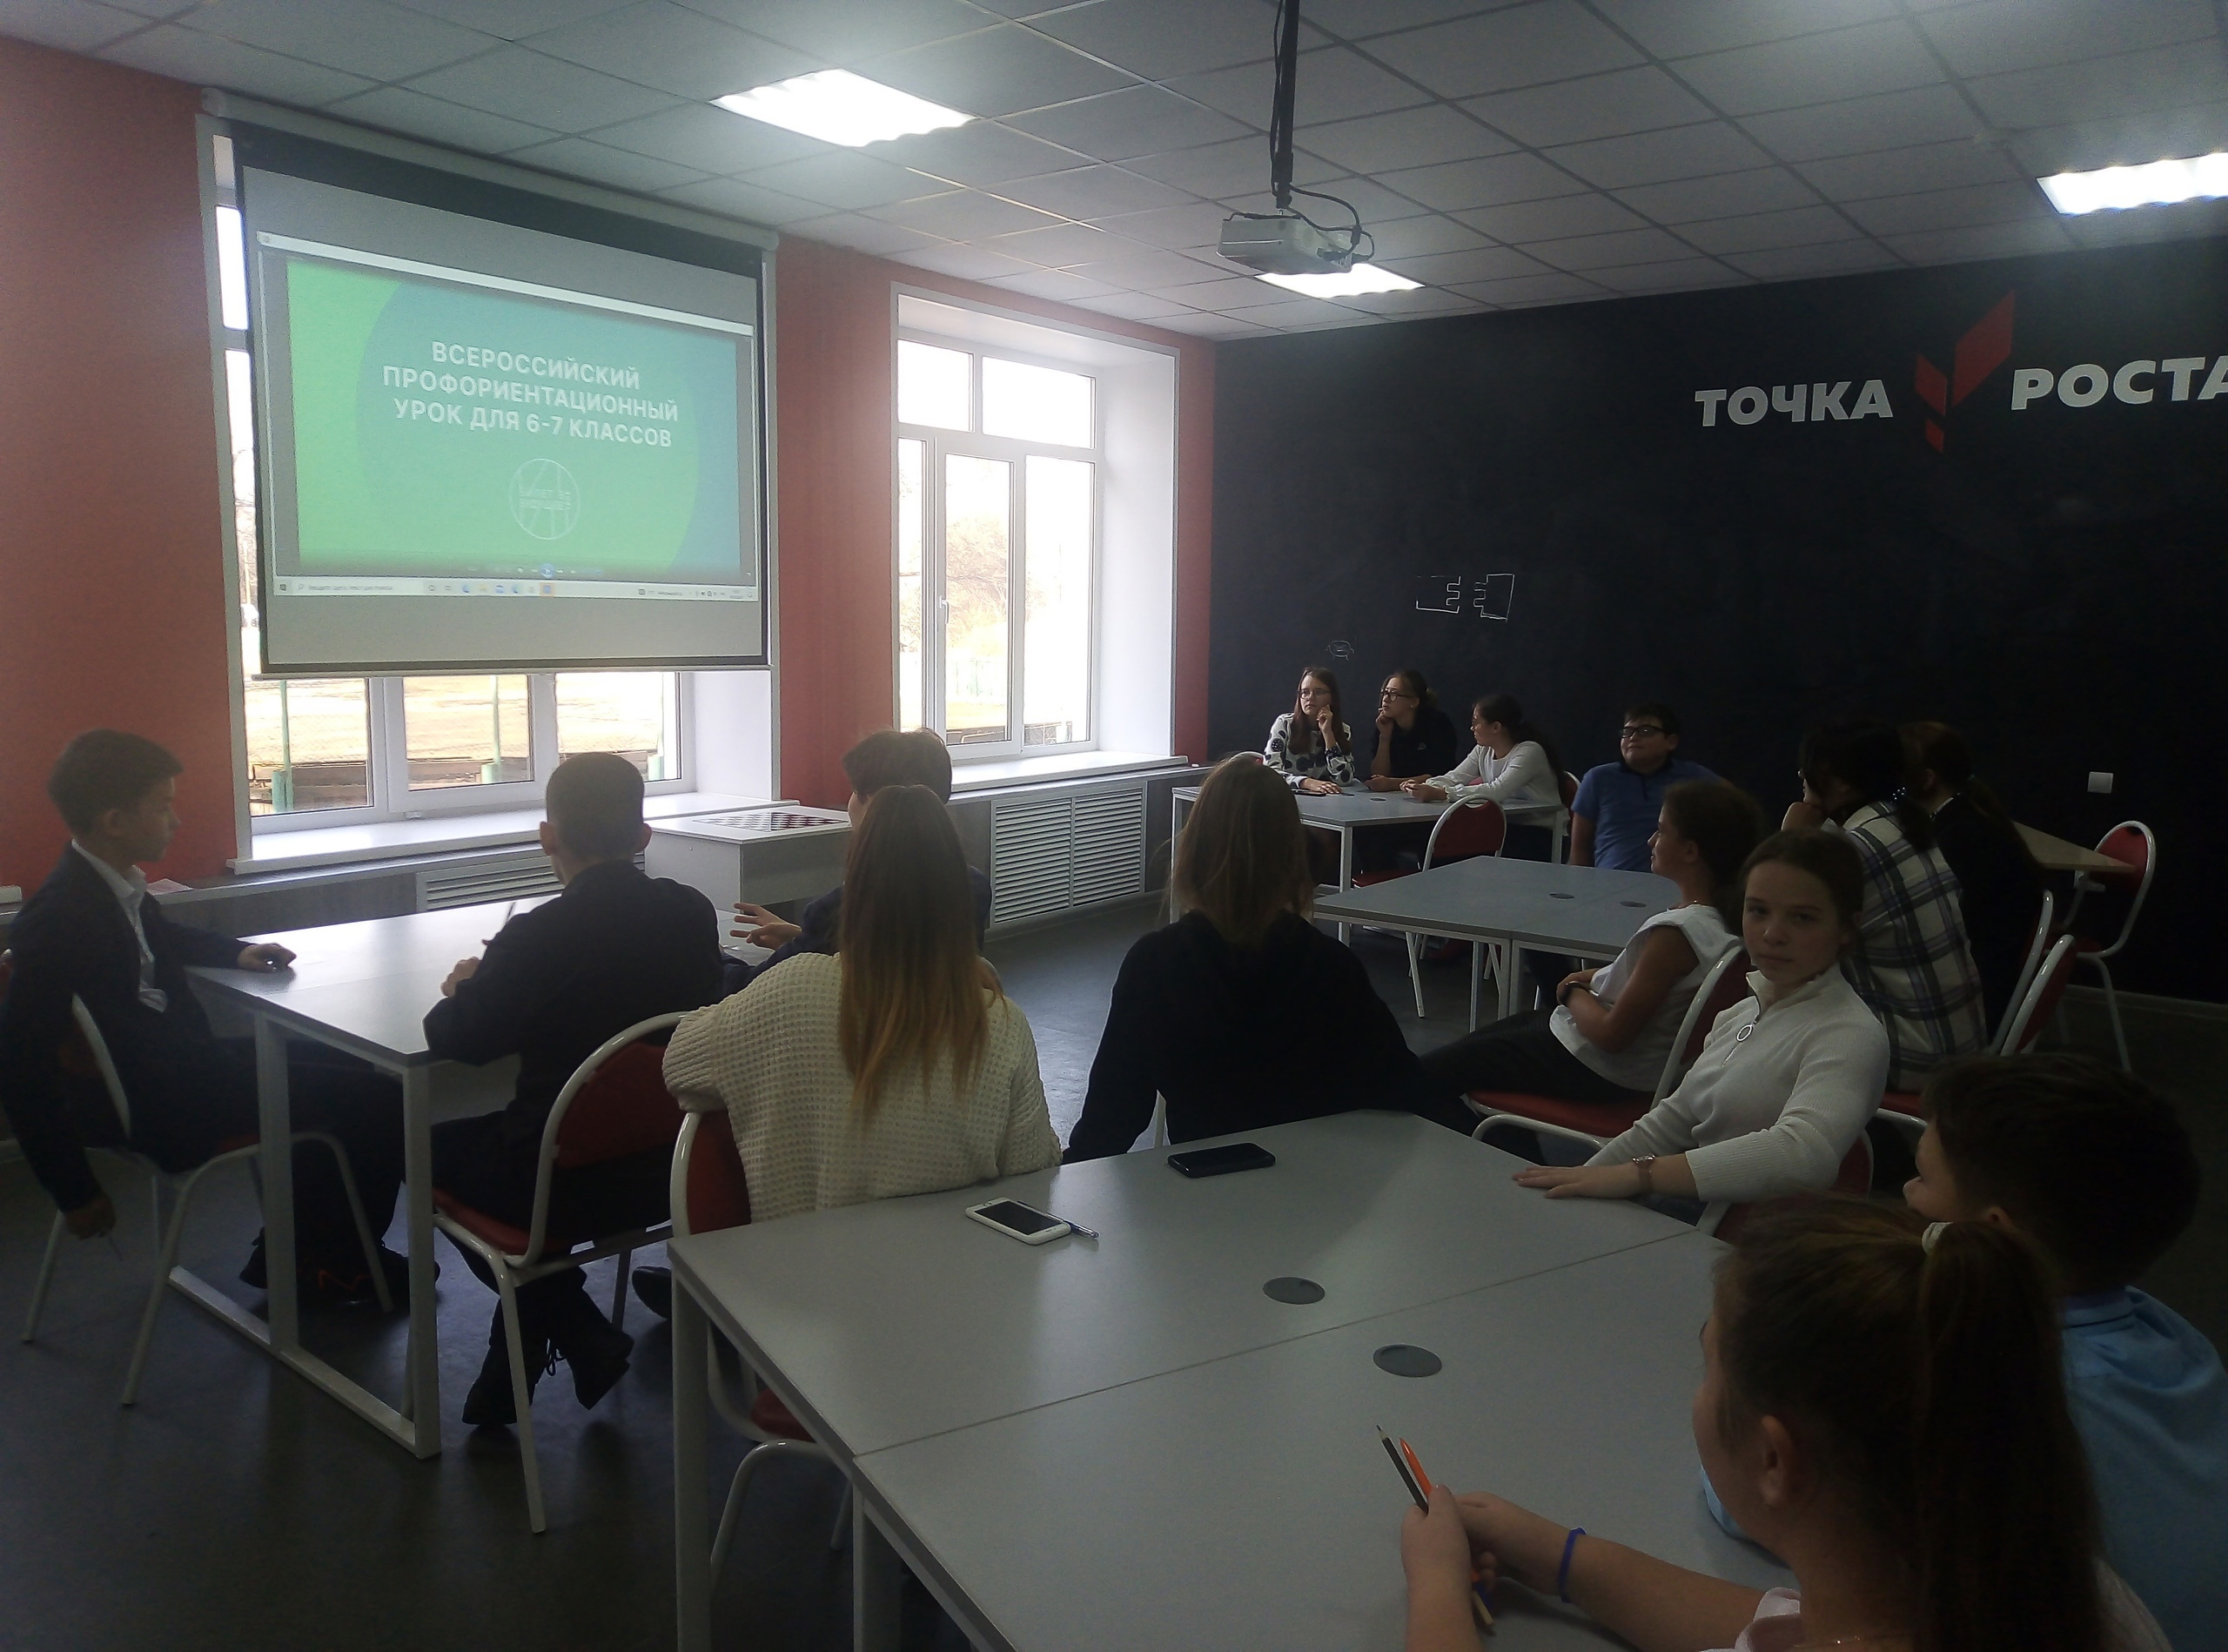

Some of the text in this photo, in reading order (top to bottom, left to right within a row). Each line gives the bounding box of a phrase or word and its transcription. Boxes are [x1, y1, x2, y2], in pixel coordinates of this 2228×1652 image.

[432, 340, 640, 390] ВСЕРОССИЙСКИЙ
[382, 365, 678, 422] ПРОФОРИЕНТАЦИОННЫЙ
[1694, 379, 1894, 426] ТОЧКА
[393, 397, 672, 447] УРОК ДЛЯ 6-7 КЛАССОВ
